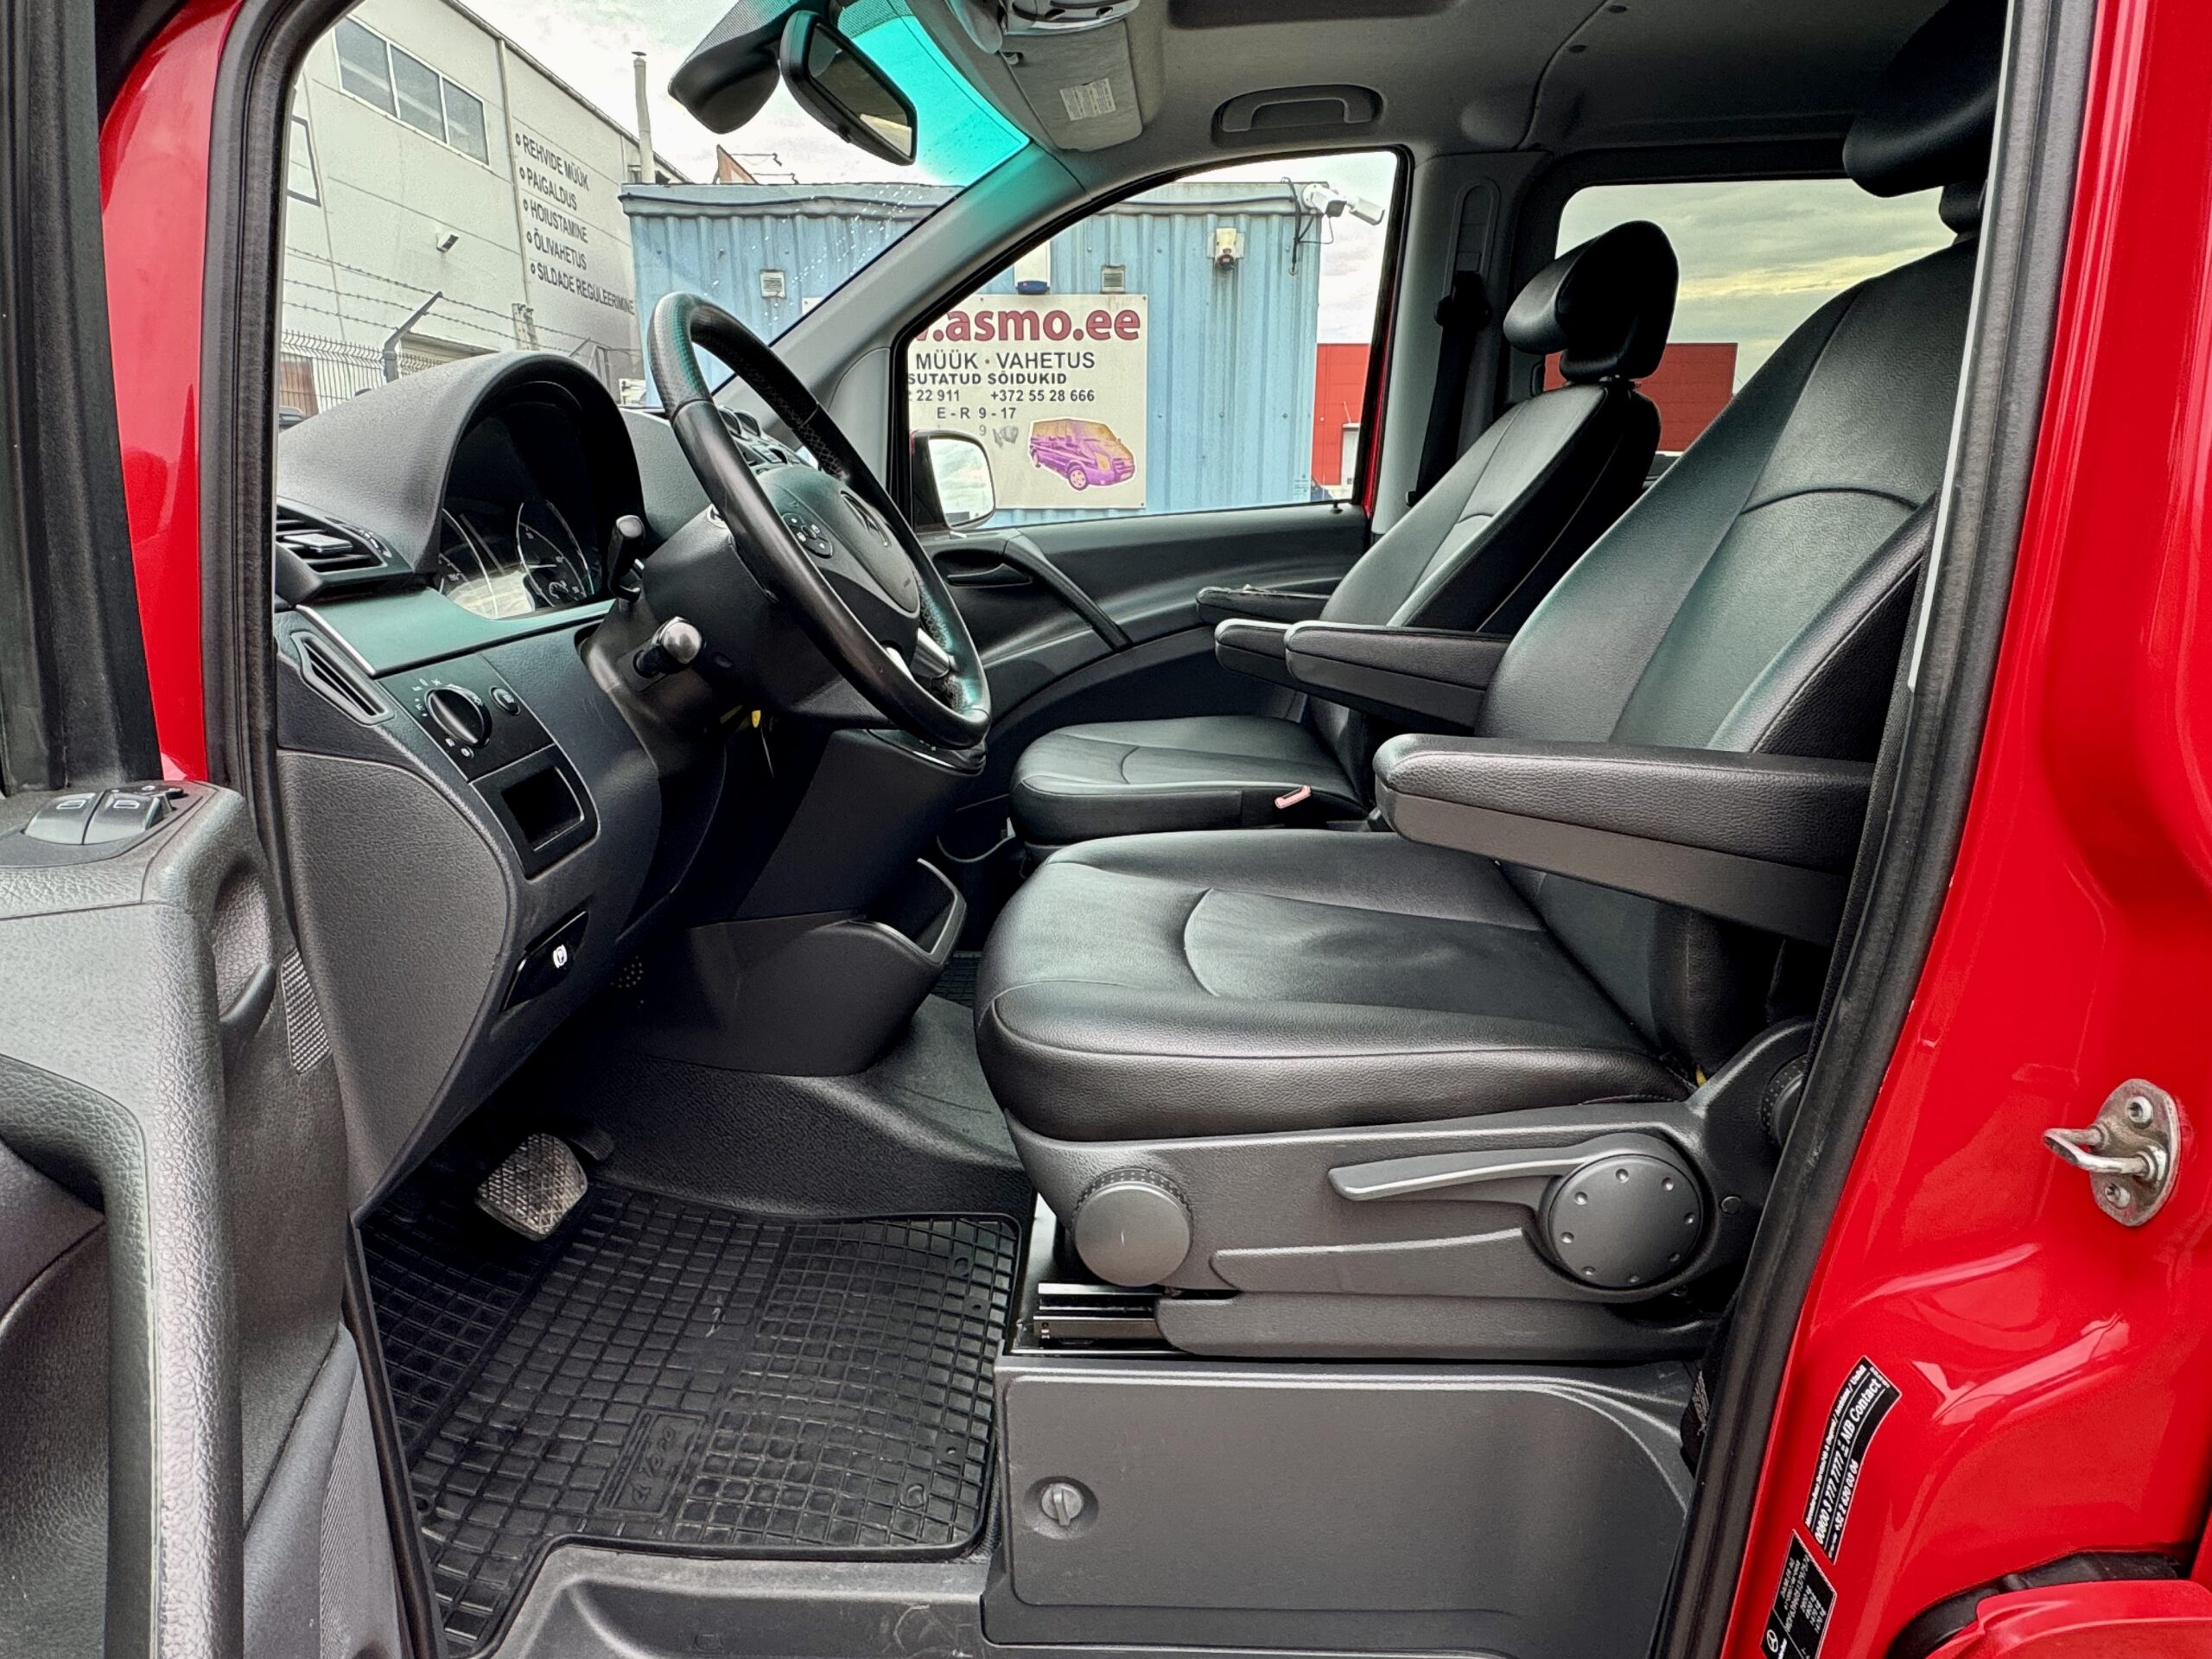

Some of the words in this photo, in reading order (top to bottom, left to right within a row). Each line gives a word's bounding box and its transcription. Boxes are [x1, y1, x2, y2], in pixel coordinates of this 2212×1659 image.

[523, 135, 563, 175] REHVIDE
[564, 162, 590, 192] MÜÜK
[526, 167, 577, 211] PAIGALDUS
[530, 200, 588, 244] HOIUSTAMINE
[533, 227, 588, 270] ÕLIVAHETUS
[537, 262, 575, 294] SILDADE
[576, 278, 635, 315] REGULEERIMINE
[916, 349, 978, 370] MÜÜK
[996, 352, 1096, 369] VAHETUS
[988, 371, 1067, 385] SÕIDUKID
[916, 389, 933, 402] 22
[938, 389, 960, 402] 911
[937, 407, 946, 419] E
[960, 407, 970, 419] R
[979, 407, 987, 419] 9
[1001, 407, 1016, 419] 17
[991, 390, 1024, 402] +372
[1028, 390, 1045, 402] 55
[1049, 390, 1065, 402] 28
[1070, 390, 1095, 402] 666
[1840, 1419, 1856, 1445] MB
[1849, 1377, 1882, 1422] Contact
[1815, 1508, 1830, 1545] 00800
[1825, 1478, 1837, 1504] 777
